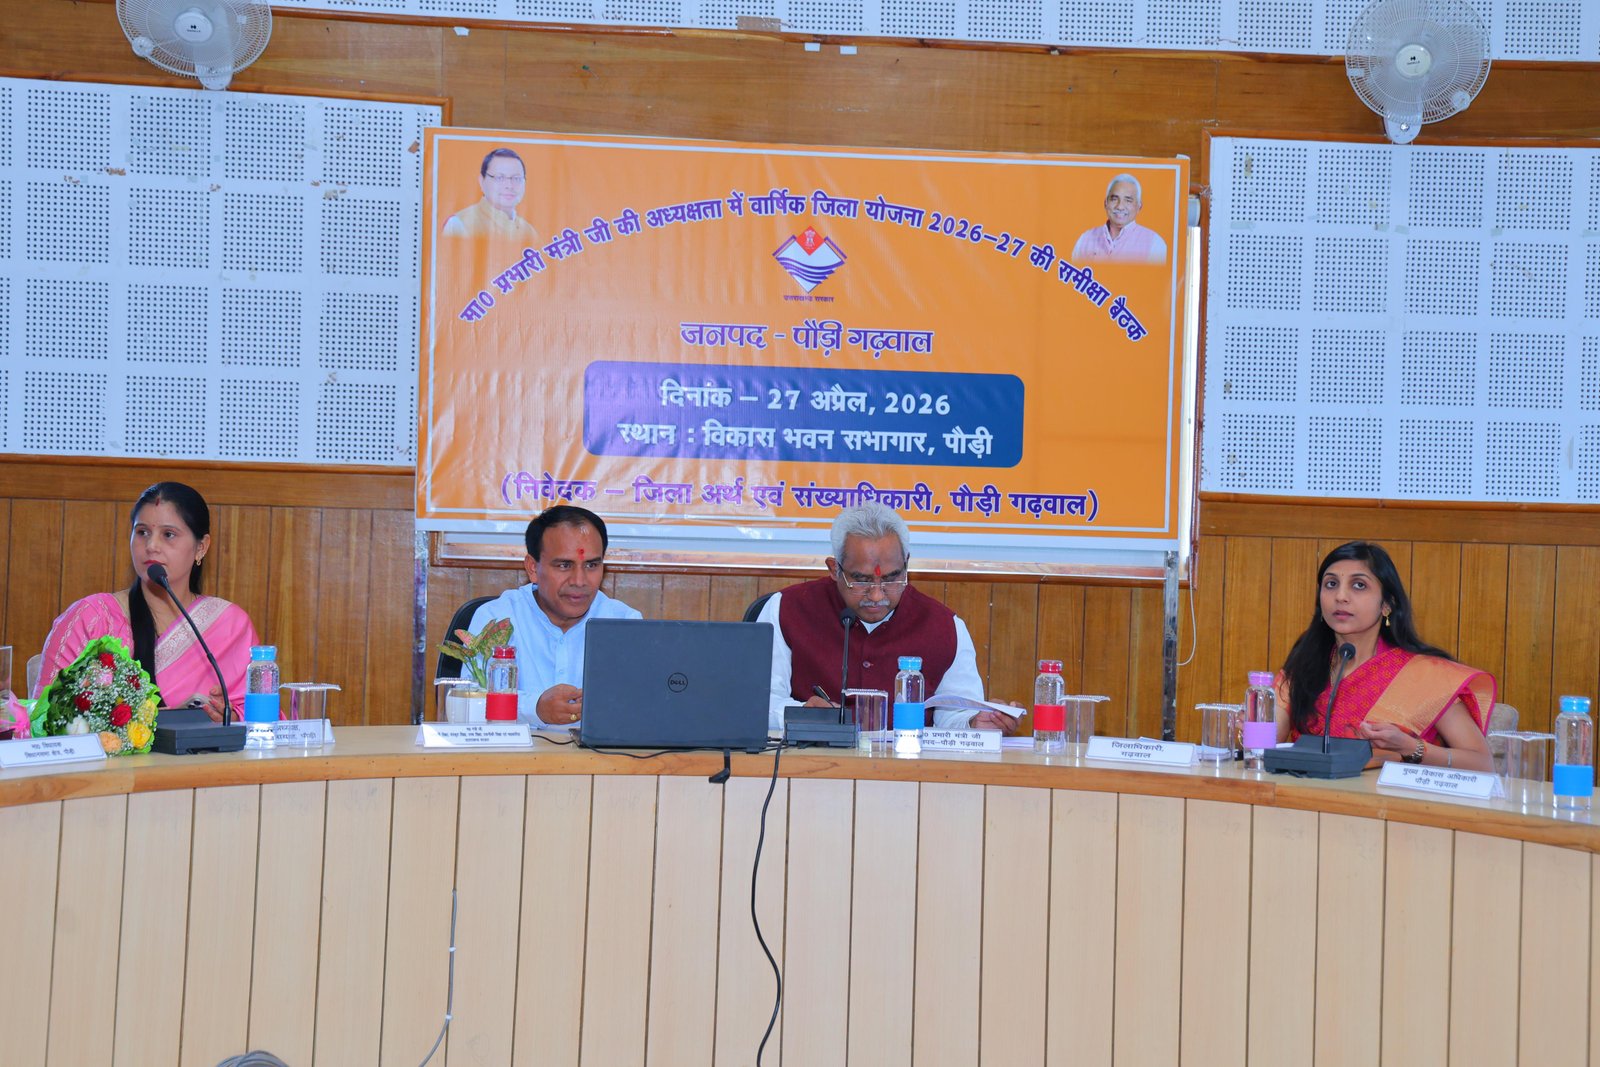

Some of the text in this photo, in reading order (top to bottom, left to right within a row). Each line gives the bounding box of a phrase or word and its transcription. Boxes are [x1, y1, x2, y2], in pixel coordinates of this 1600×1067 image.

[493, 248, 546, 293] प्रभारी
[543, 228, 583, 259] मंत्री
[584, 217, 612, 244] जी
[614, 208, 641, 235] की
[646, 199, 723, 227] अध्यक्षता
[727, 191, 744, 216] में
[748, 189, 806, 215] वार्षिक
[811, 190, 859, 217] जिला
[864, 195, 925, 227] योजना
[1029, 245, 1055, 271] की
[1057, 260, 1111, 307] समीक्षा
[680, 322, 767, 349] जनपद
[792, 319, 843, 357] पौड़ी
[848, 328, 934, 359] गढ़वाल
[660, 378, 733, 408] दिनांक
[767, 388, 801, 410] 27
[810, 383, 876, 415] अप्रैल,
[884, 392, 951, 415] 2026
[617, 423, 677, 445] स्थान
[702, 418, 776, 448] विकास
[783, 428, 834, 450] भवन
[840, 430, 935, 456] सभागार,
[942, 425, 993, 459] पौड़ी
[501, 471, 597, 505] (निवेदक
[632, 474, 693, 504] जिला
[701, 477, 743, 504] अर्थ
[751, 481, 785, 509] एवं
[791, 481, 941, 514] संख्याधिकारी,
[950, 484, 1001, 517] पौड़ी
[1008, 489, 1099, 521] गढ़वाल)
[1421, 768, 1445, 778] विकास
